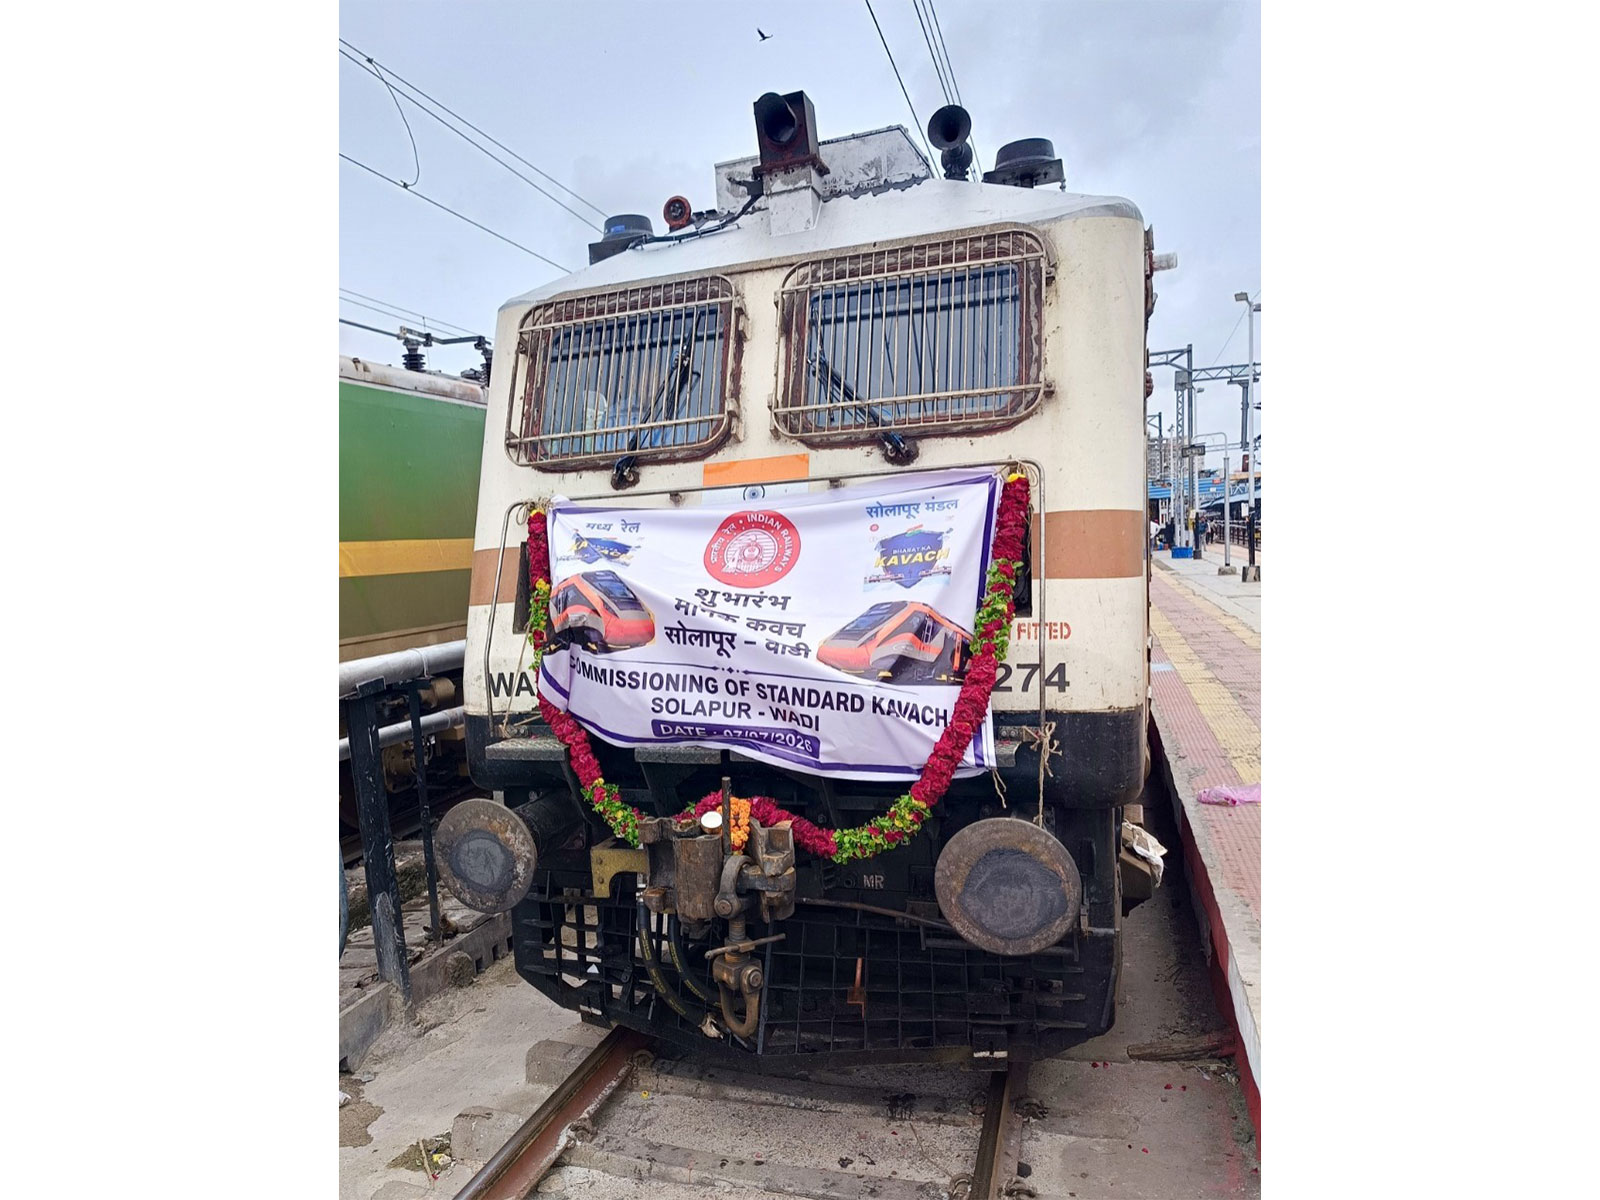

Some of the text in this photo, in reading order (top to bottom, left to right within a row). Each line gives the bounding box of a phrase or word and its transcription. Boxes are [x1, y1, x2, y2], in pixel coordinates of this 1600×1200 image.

[866, 496, 960, 519] सोलापूर मंडल
[621, 519, 640, 533] रेल
[747, 514, 793, 573] INDIAN RAILWAYS
[874, 548, 950, 568] KAVACH
[695, 588, 791, 611] शुभारंभ
[664, 620, 737, 658] सोलापूर
[746, 617, 806, 638] कवच
[651, 697, 752, 719] SOLAPUR
[769, 706, 819, 731] WADI
[725, 678, 750, 697] OF
[756, 682, 864, 713] STANDARD
[872, 695, 948, 728] KAVACH
[660, 723, 706, 737] DATE
[863, 874, 884, 889] MR
